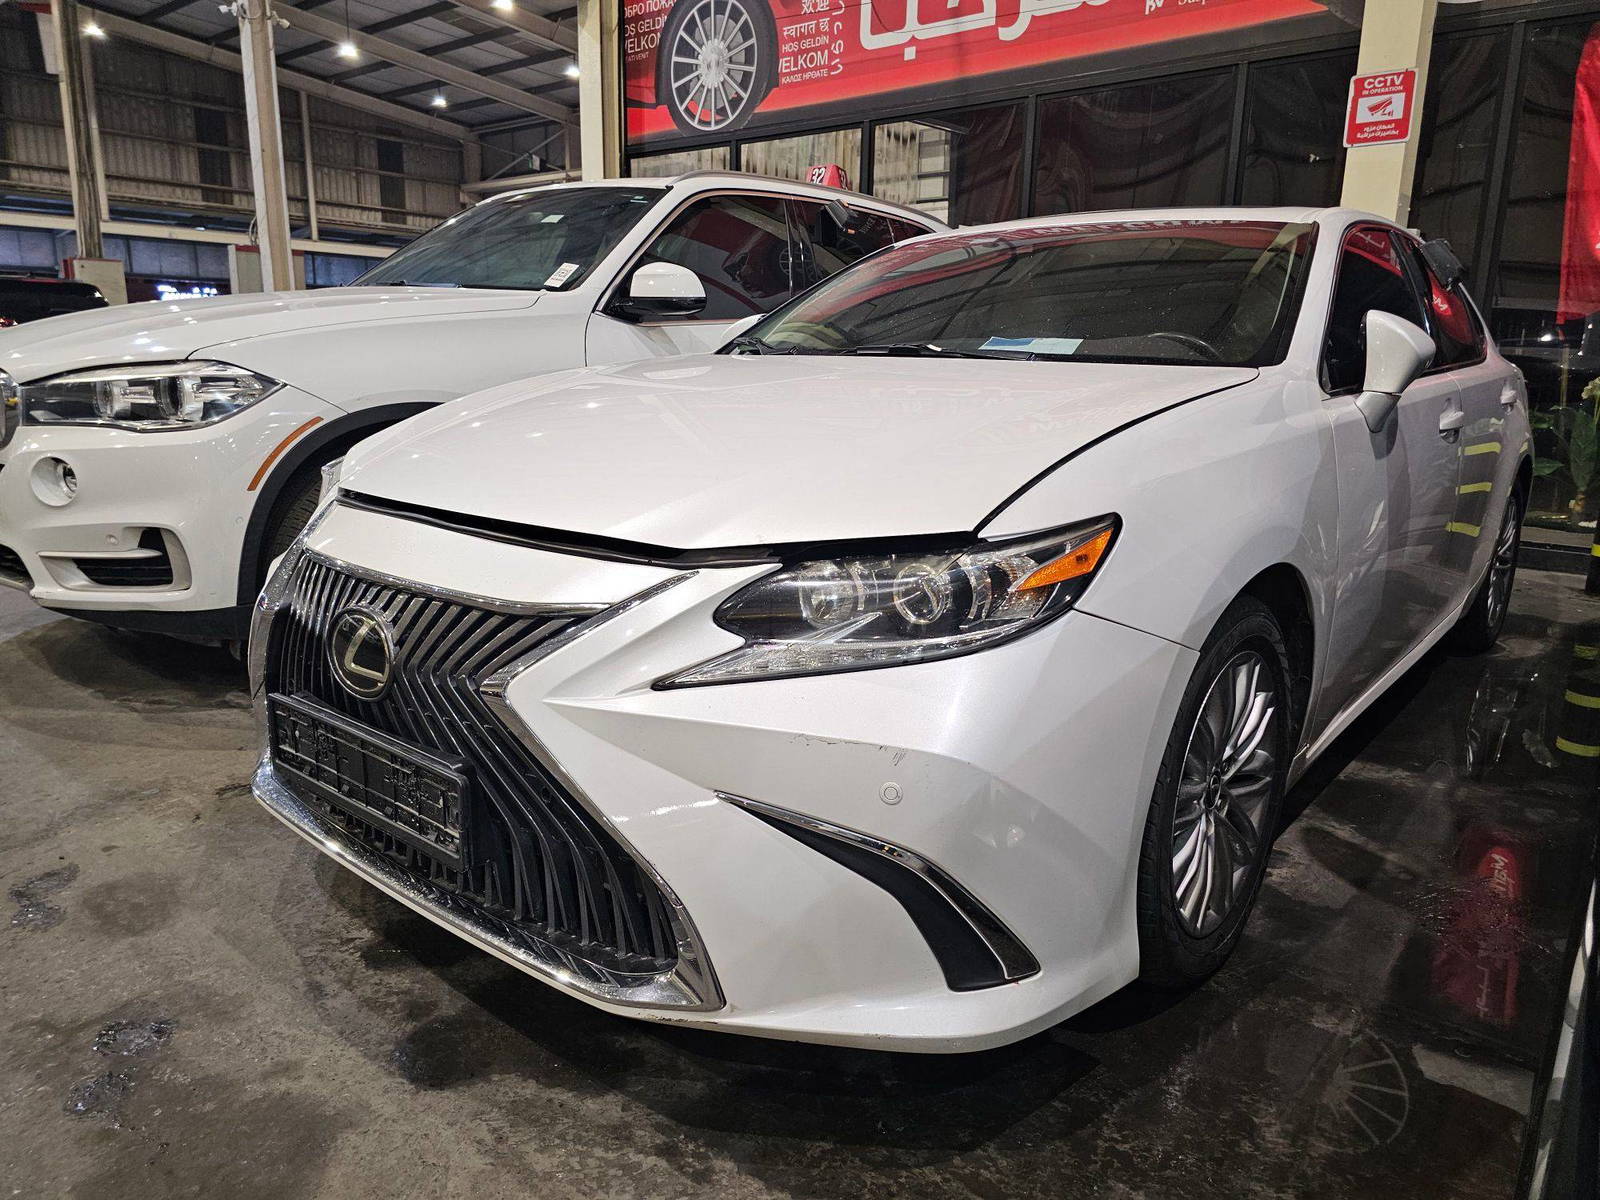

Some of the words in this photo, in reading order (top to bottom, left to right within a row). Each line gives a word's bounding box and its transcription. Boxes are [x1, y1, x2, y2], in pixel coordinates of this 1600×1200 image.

[625, 32, 660, 53] ELKO
[1364, 74, 1404, 88] CCTV
[1370, 86, 1403, 95] OPERATION
[810, 167, 826, 185] 32
